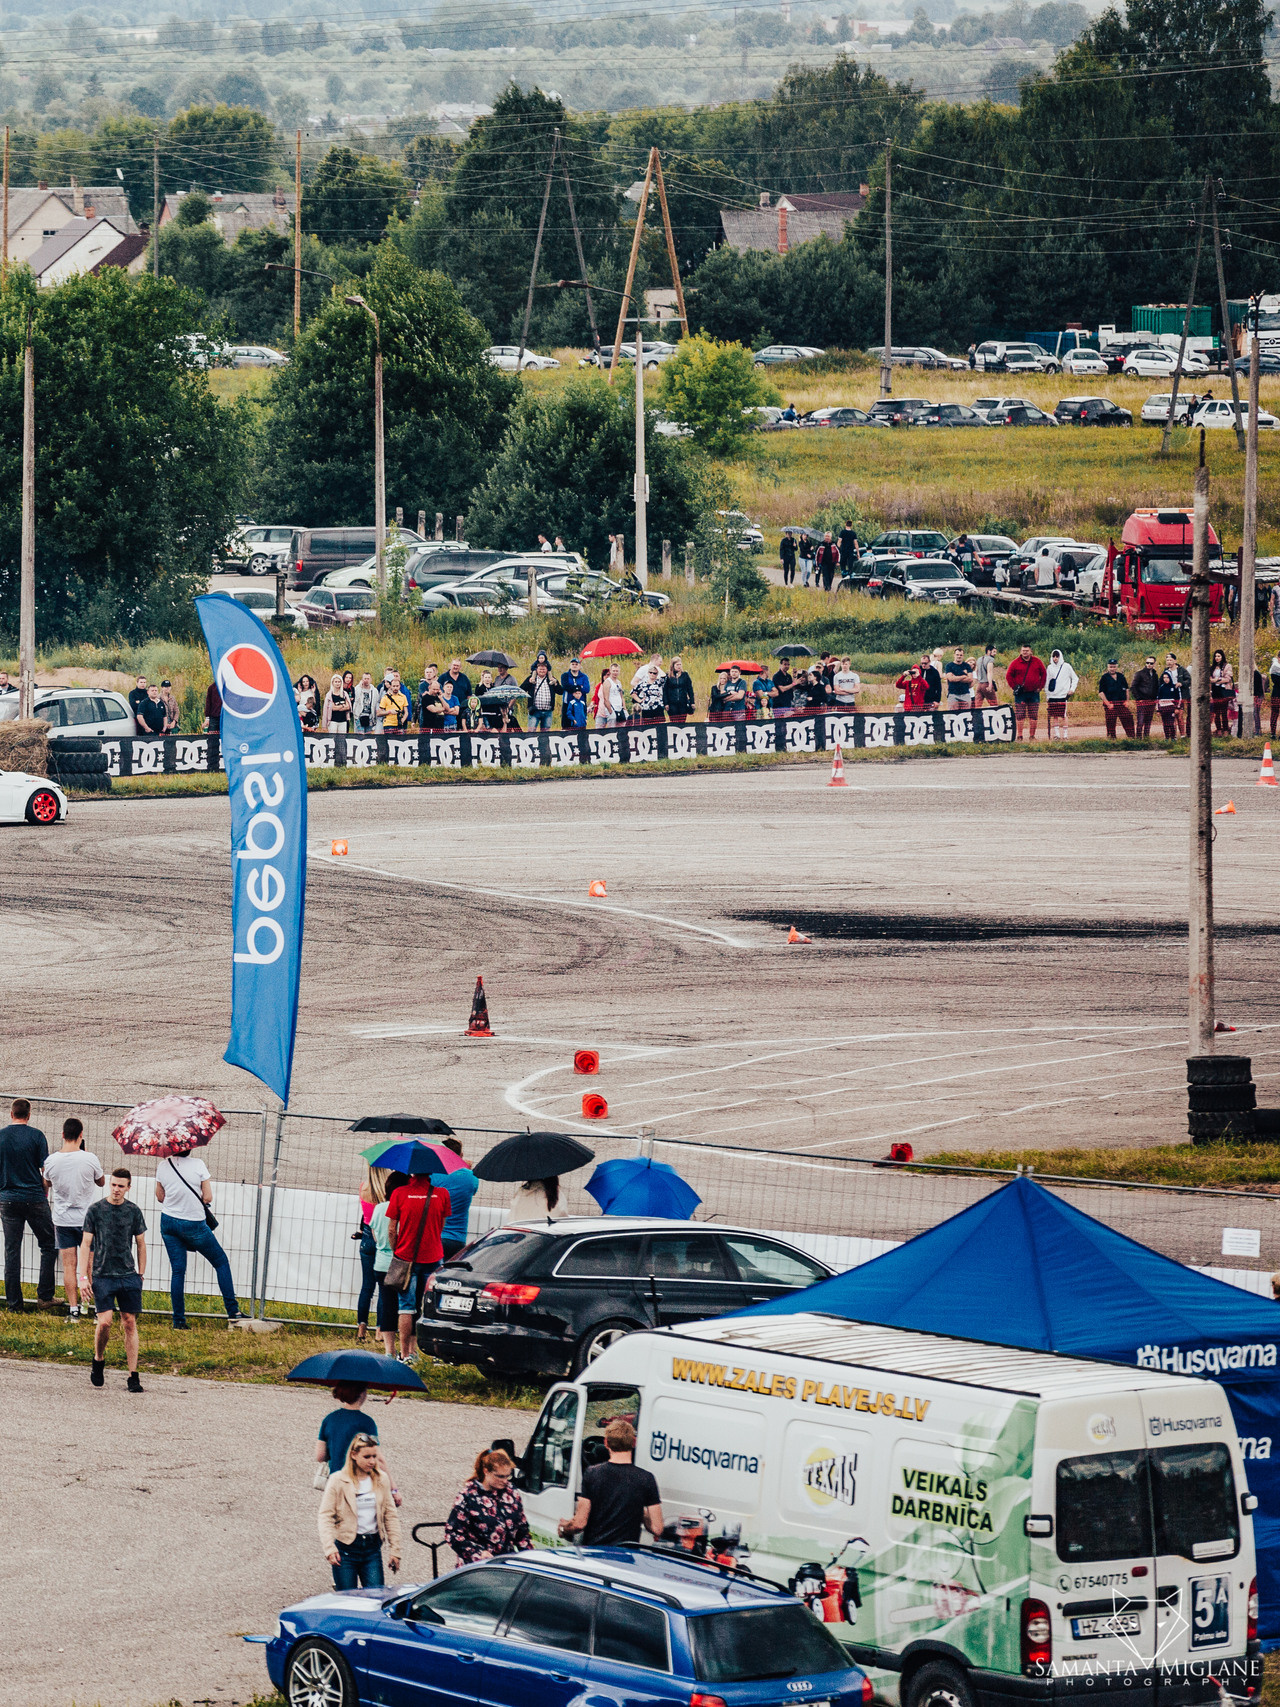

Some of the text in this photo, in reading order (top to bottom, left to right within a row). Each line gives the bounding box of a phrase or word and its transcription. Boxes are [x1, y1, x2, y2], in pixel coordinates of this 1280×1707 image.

[1161, 1344, 1277, 1375] Husqvarna
[802, 1379, 931, 1422] PLAVEJS.LV
[1163, 1416, 1222, 1433] Husqvarna
[668, 1437, 759, 1474] Husqvarna
[803, 1453, 858, 1506] TEXAS
[903, 1468, 988, 1502] VEIKALS
[892, 1494, 994, 1533] DARBNĪCA
[1074, 1572, 1129, 1589] 67540775
